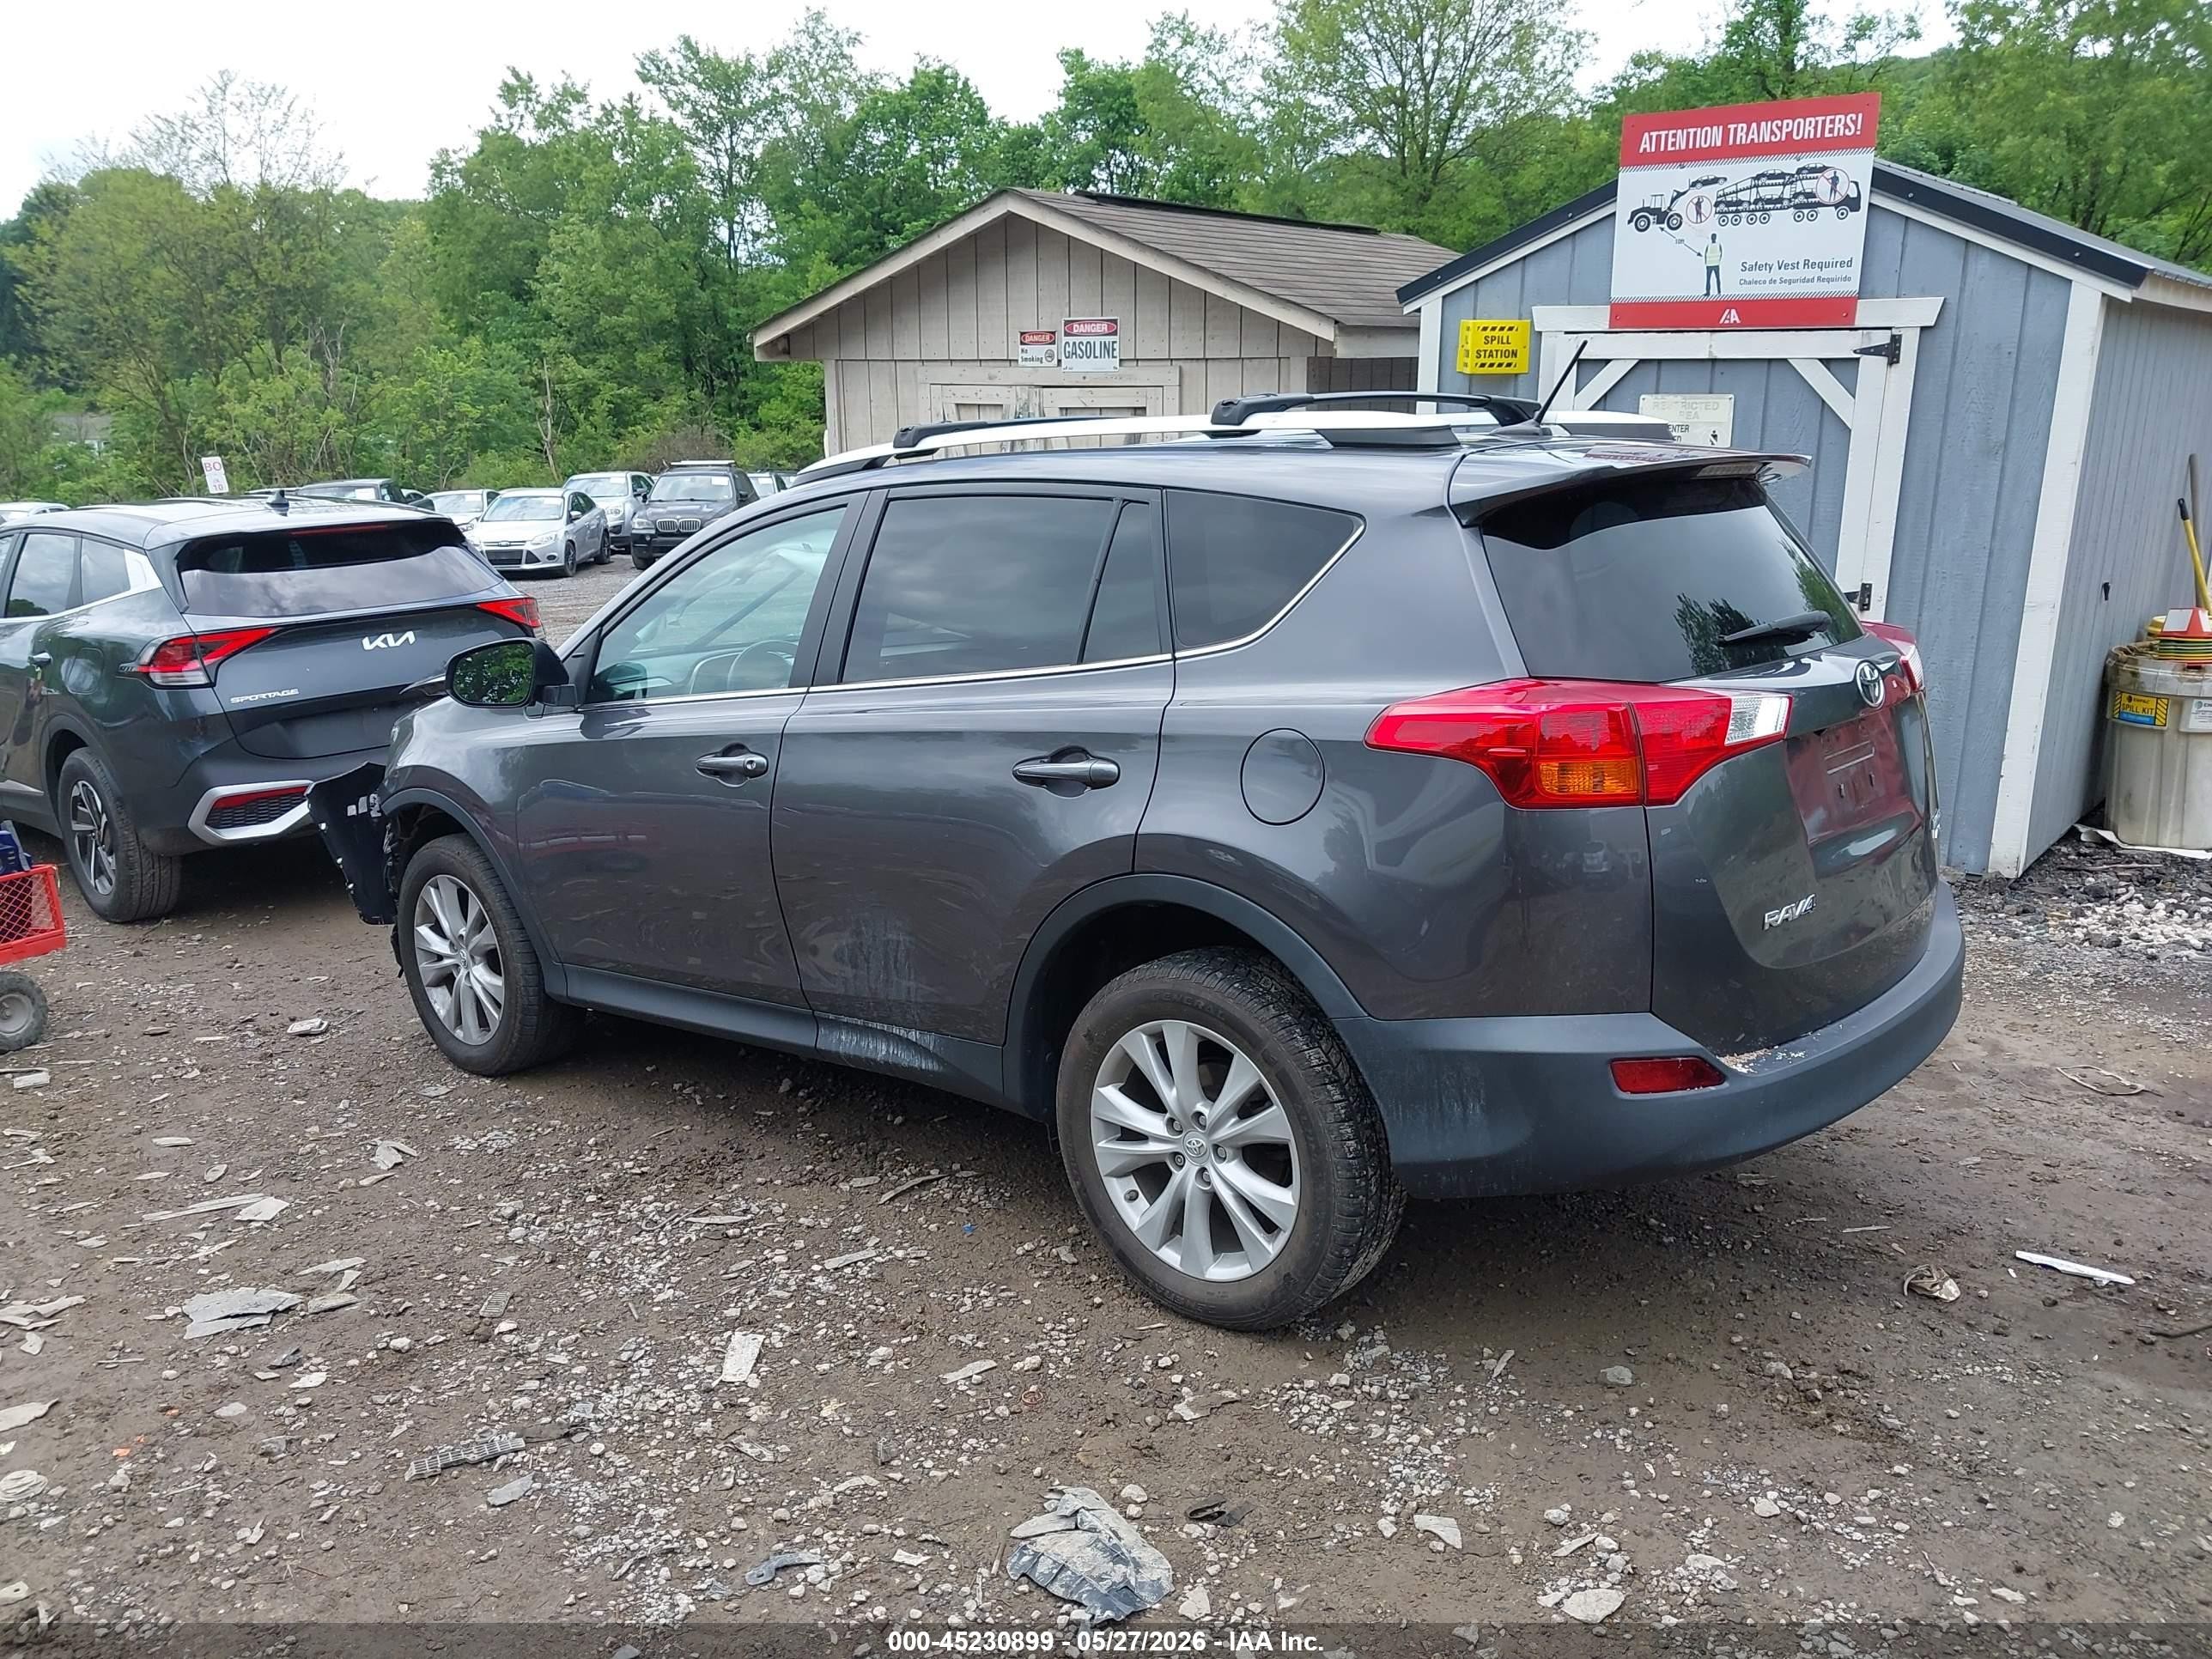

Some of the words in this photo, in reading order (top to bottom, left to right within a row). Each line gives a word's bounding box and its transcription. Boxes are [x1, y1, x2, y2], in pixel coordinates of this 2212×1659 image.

[1638, 125, 1723, 154] ATTENTION
[1727, 112, 1863, 146] TRANSPORTERS!
[1741, 261, 1774, 274] Safety
[1777, 259, 1800, 270] Vest
[1802, 257, 1853, 271] Required
[1739, 277, 1766, 286] Chaleco
[1768, 276, 1778, 285] de
[1778, 276, 1815, 286] Seguridad
[1816, 275, 1852, 285] Requirido
[1073, 323, 1108, 333] DANGER
[1483, 335, 1511, 345] SPILL
[1063, 340, 1118, 359] GASOLINE
[1475, 349, 1518, 359] STATION
[1652, 401, 1720, 410] RETRICTED
[362, 630, 416, 650] KIA
[230, 688, 300, 704] SPORTAGE
[2122, 702, 2140, 714] SPILL
[1763, 893, 1816, 930] RAV4
